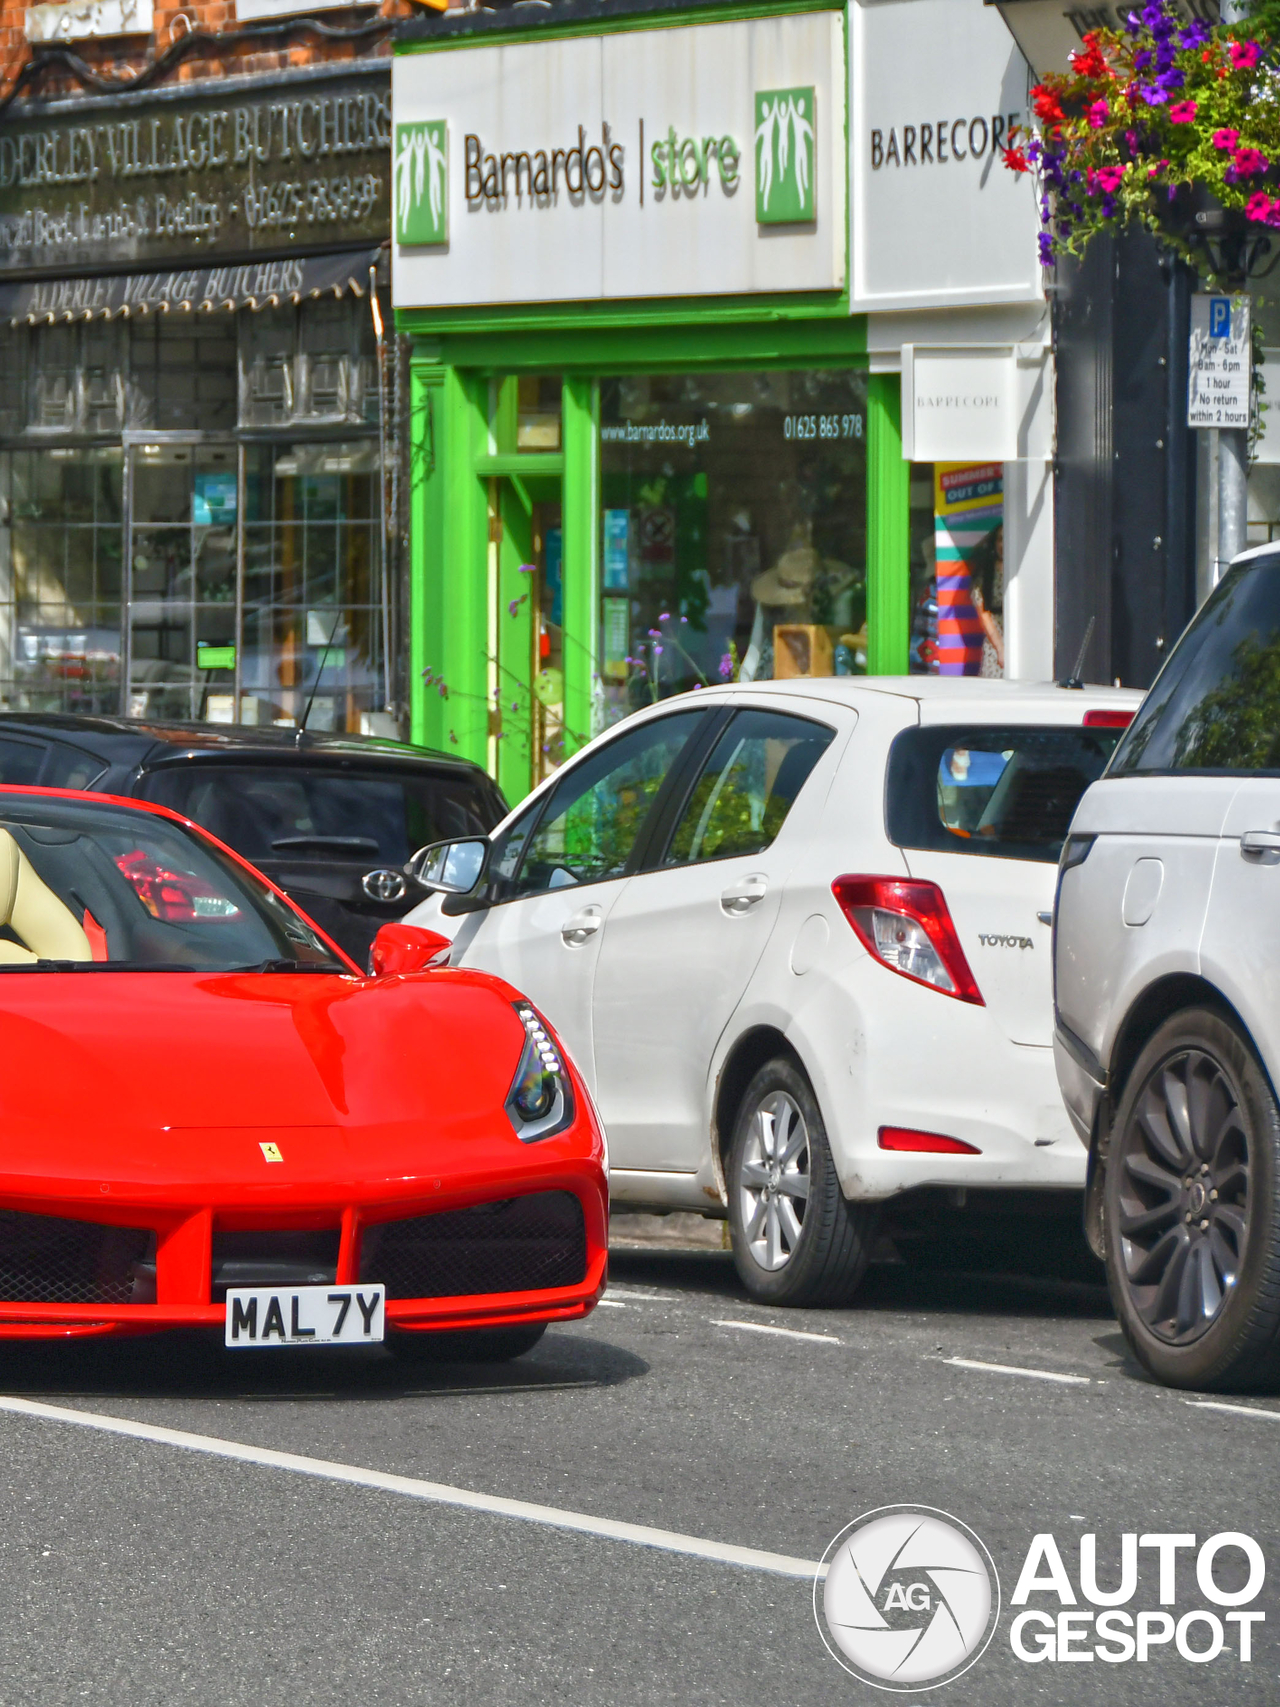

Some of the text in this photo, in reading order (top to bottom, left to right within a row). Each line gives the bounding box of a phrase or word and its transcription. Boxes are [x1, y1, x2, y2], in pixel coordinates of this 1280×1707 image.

[106, 112, 228, 175] VILLAGE
[464, 121, 740, 204] Barnardo's store
[26, 259, 306, 312] ALDERLEY VILLAGE BUTCHERS
[1213, 301, 1226, 334] P
[1201, 343, 1217, 355] Mon
[1224, 342, 1238, 355] Sat
[1222, 359, 1240, 372] 6pm
[1213, 377, 1231, 389] hour
[1200, 394, 1238, 405] No return
[784, 414, 863, 440] 01625 865 978
[1190, 410, 1247, 423] within 2 hours
[601, 417, 710, 448] www.barnardos.org.uk
[947, 485, 973, 501] OUT
[977, 481, 995, 494] OF
[978, 934, 1035, 950] TOYOTA
[231, 1291, 380, 1340] MAL 7Y
